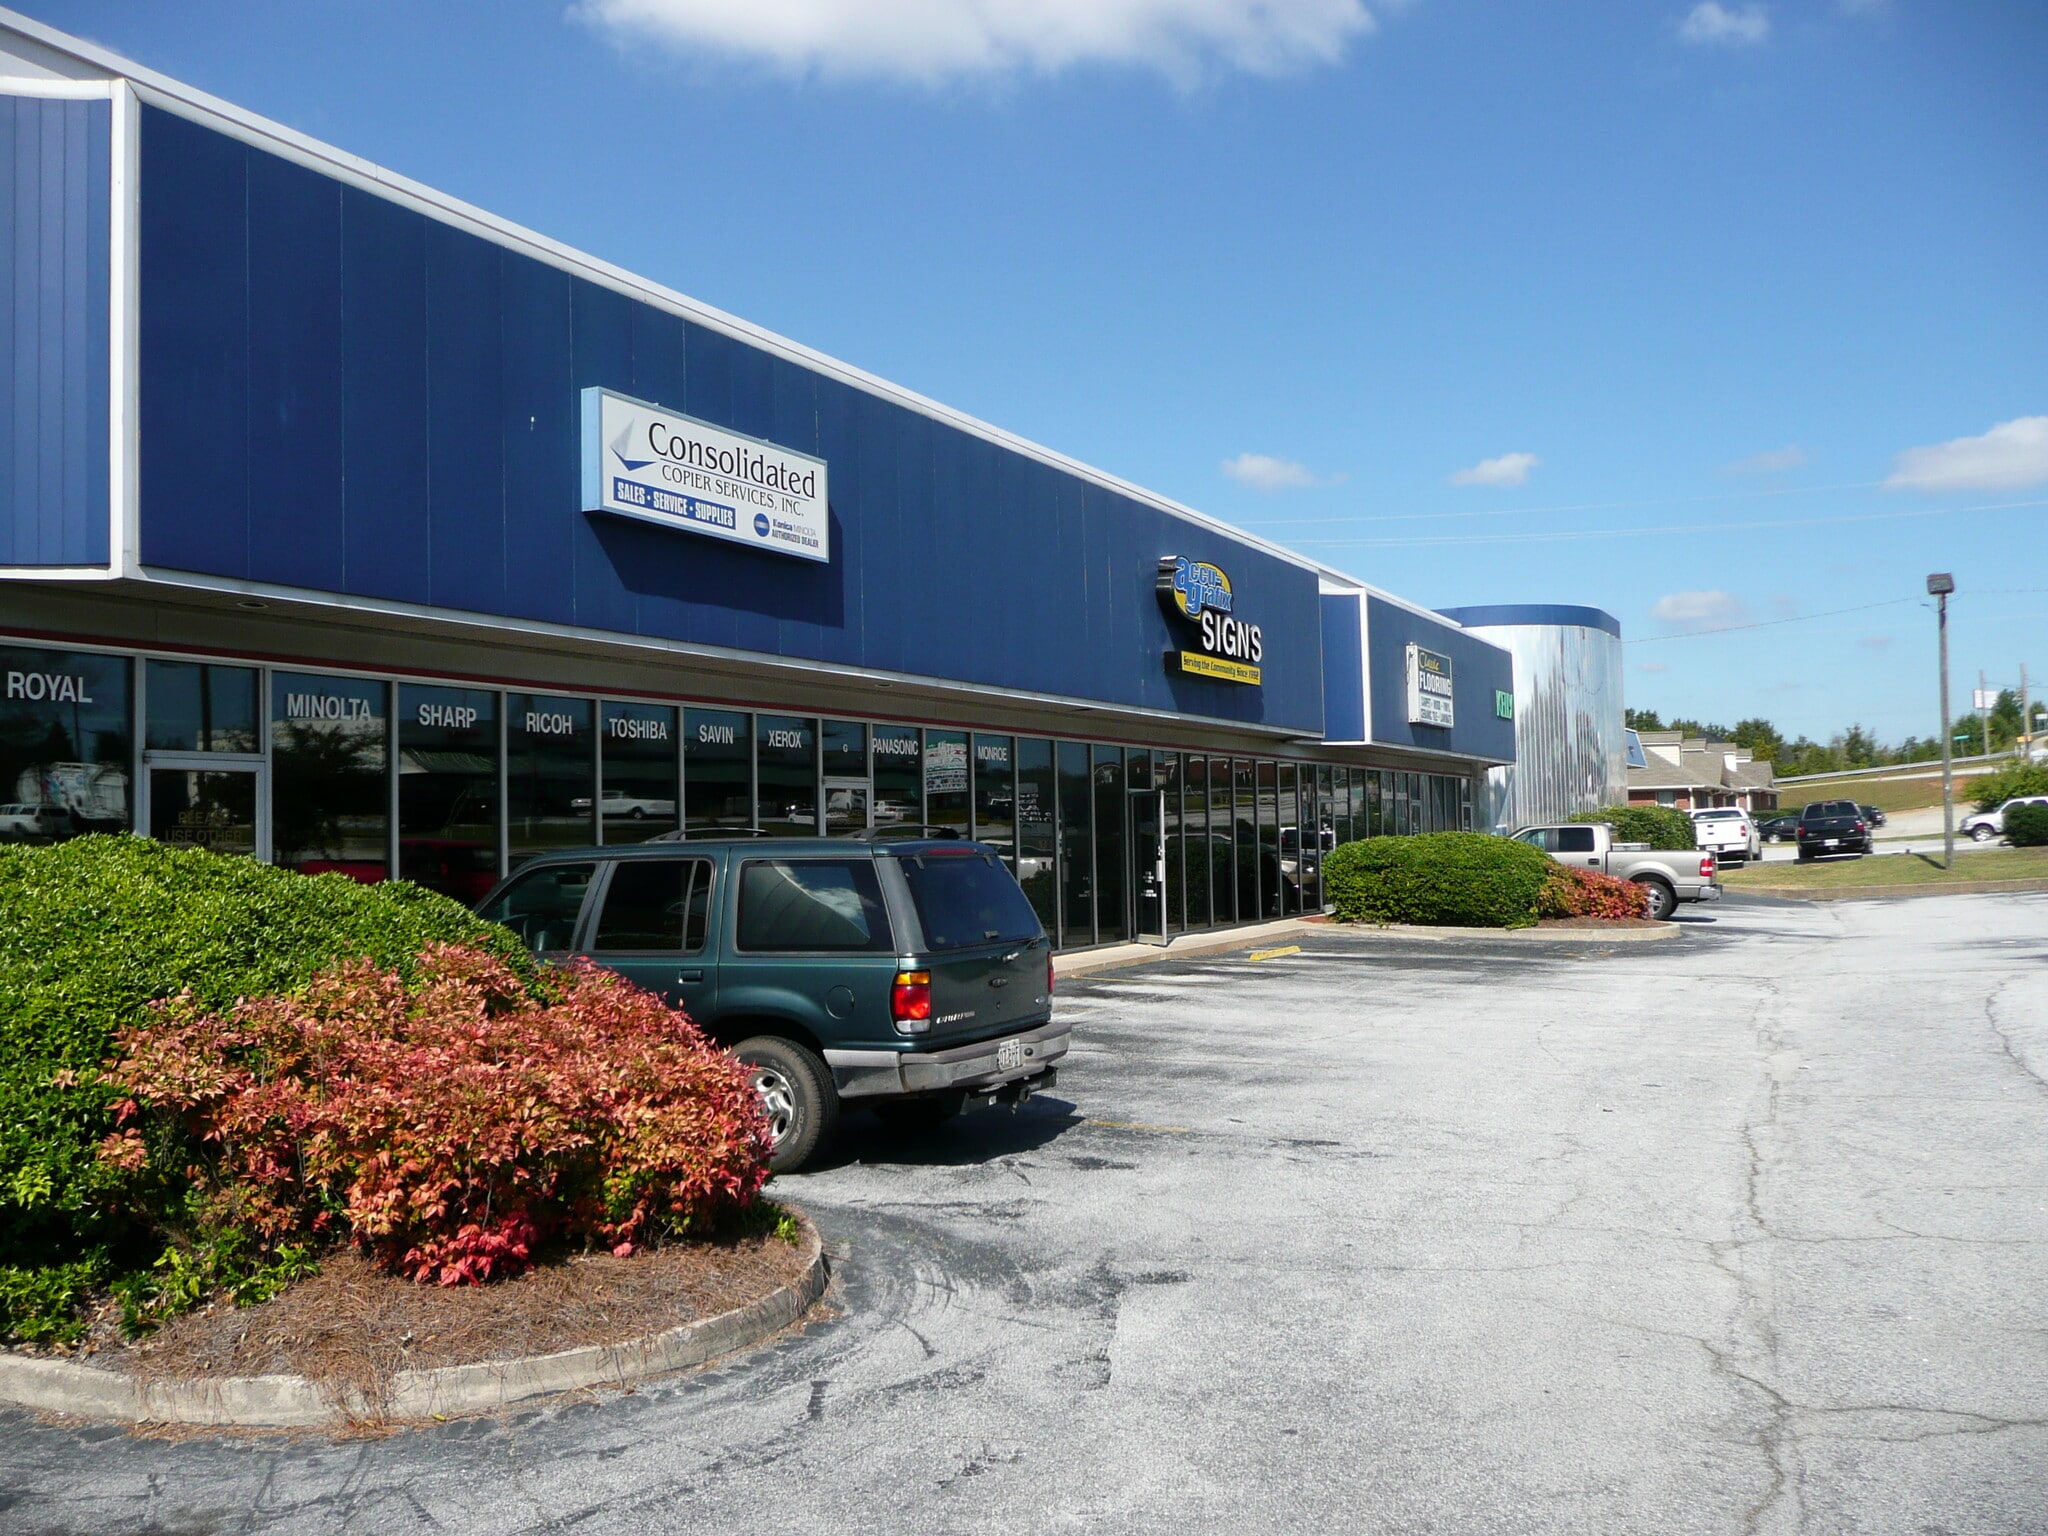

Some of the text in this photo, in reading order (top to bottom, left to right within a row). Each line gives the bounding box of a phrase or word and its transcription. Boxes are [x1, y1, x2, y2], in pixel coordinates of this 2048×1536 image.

[648, 422, 816, 498] Consolidated
[662, 465, 804, 517] COPIER SERVICES, INC.
[617, 481, 733, 527] SALES SERVICE SUPPLIES
[772, 518, 793, 531] Konica
[771, 529, 818, 548] AUTHORIZED DEALER
[1202, 610, 1262, 662] SIGNS
[1184, 656, 1201, 671] Serving
[1202, 659, 1210, 670] the
[1211, 661, 1236, 678] Community
[7, 671, 93, 703] ROYAL
[1419, 671, 1452, 697] FLOORING
[286, 693, 371, 722] MINOLTA
[418, 704, 477, 729] SHARP
[526, 712, 572, 735] RICOH
[609, 718, 668, 741] TOSHIBA
[699, 724, 734, 745] SAVIN
[768, 730, 802, 749] XEROX
[872, 737, 919, 757] PANASONIC
[977, 745, 1008, 762] MONROE
[164, 829, 242, 843] USE OTHER
